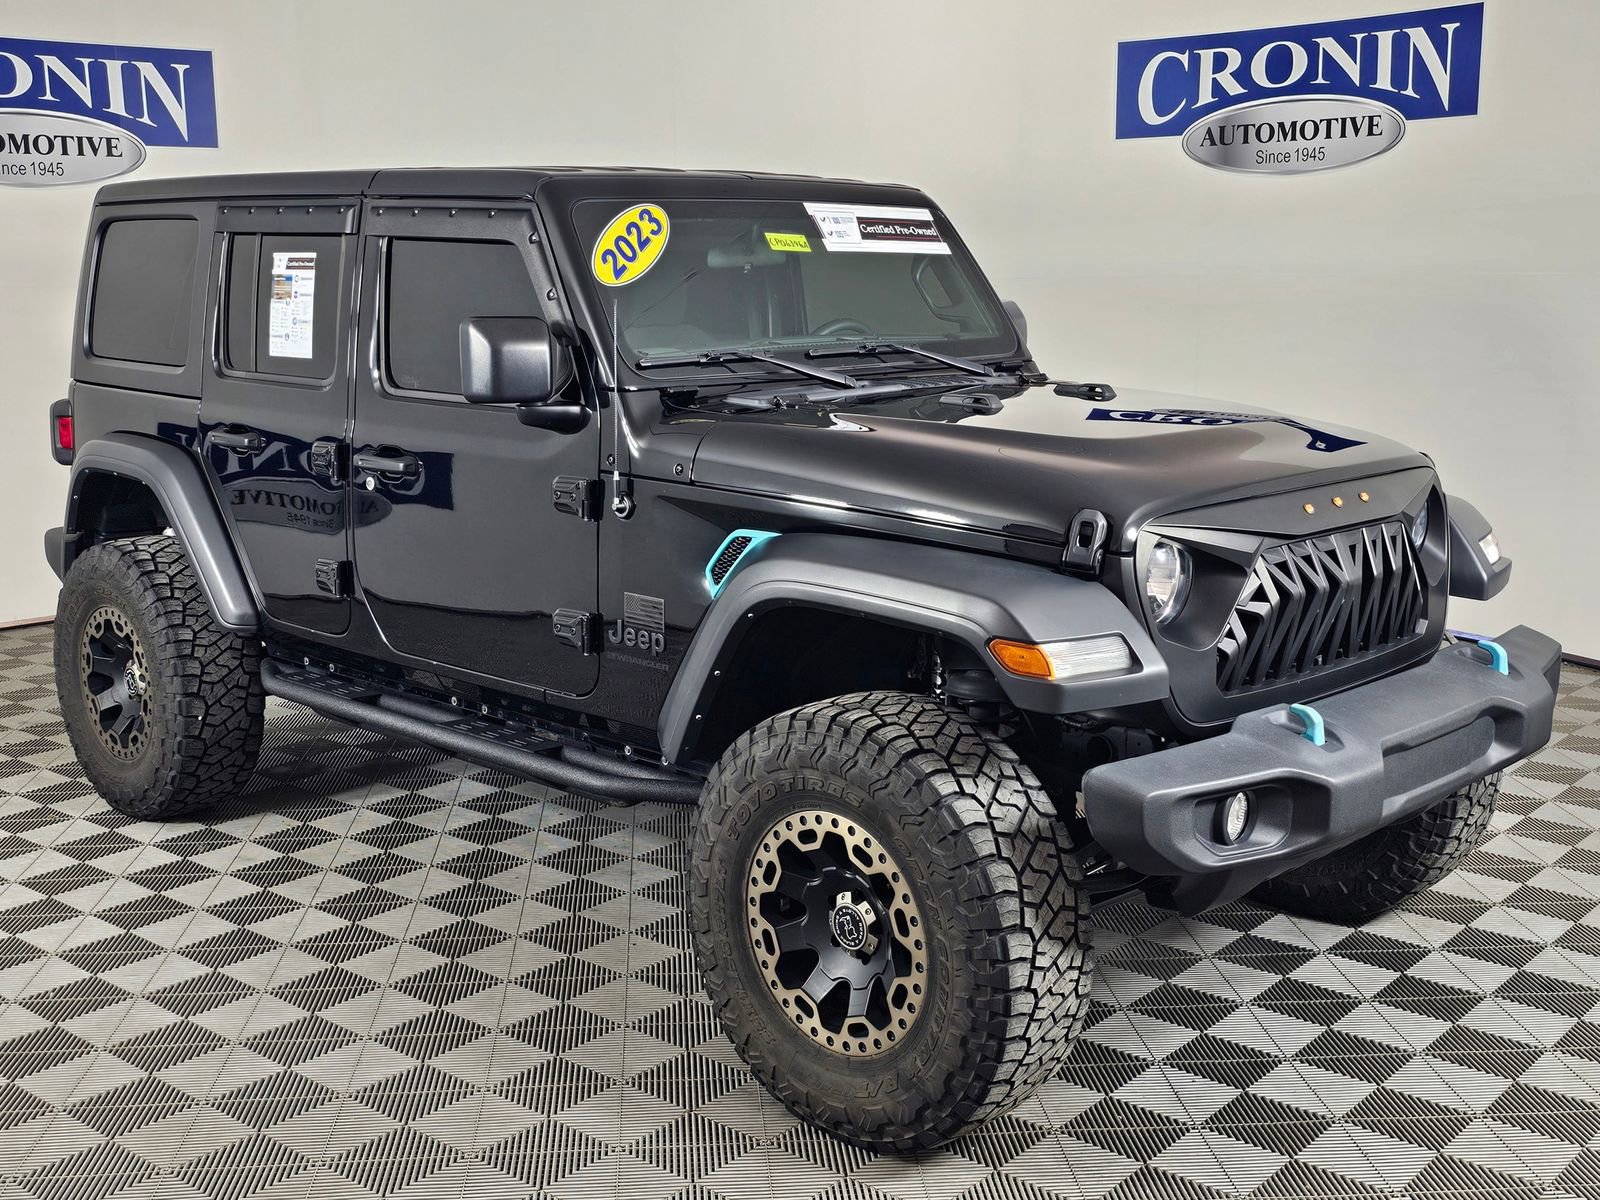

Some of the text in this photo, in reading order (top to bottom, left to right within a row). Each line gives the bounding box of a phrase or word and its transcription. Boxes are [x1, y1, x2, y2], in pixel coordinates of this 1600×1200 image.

[1137, 22, 1461, 126] CRONIN
[0, 132, 123, 158] MOTIVE
[1200, 115, 1383, 147] AUTOMOTIVE
[30, 161, 64, 176] 1945
[1255, 147, 1326, 165] Since 1945
[601, 208, 663, 281] 2023
[859, 223, 938, 236] Certified Pre-Owned
[608, 619, 665, 657] Jeep
[727, 775, 864, 840] TOYO TIRES
